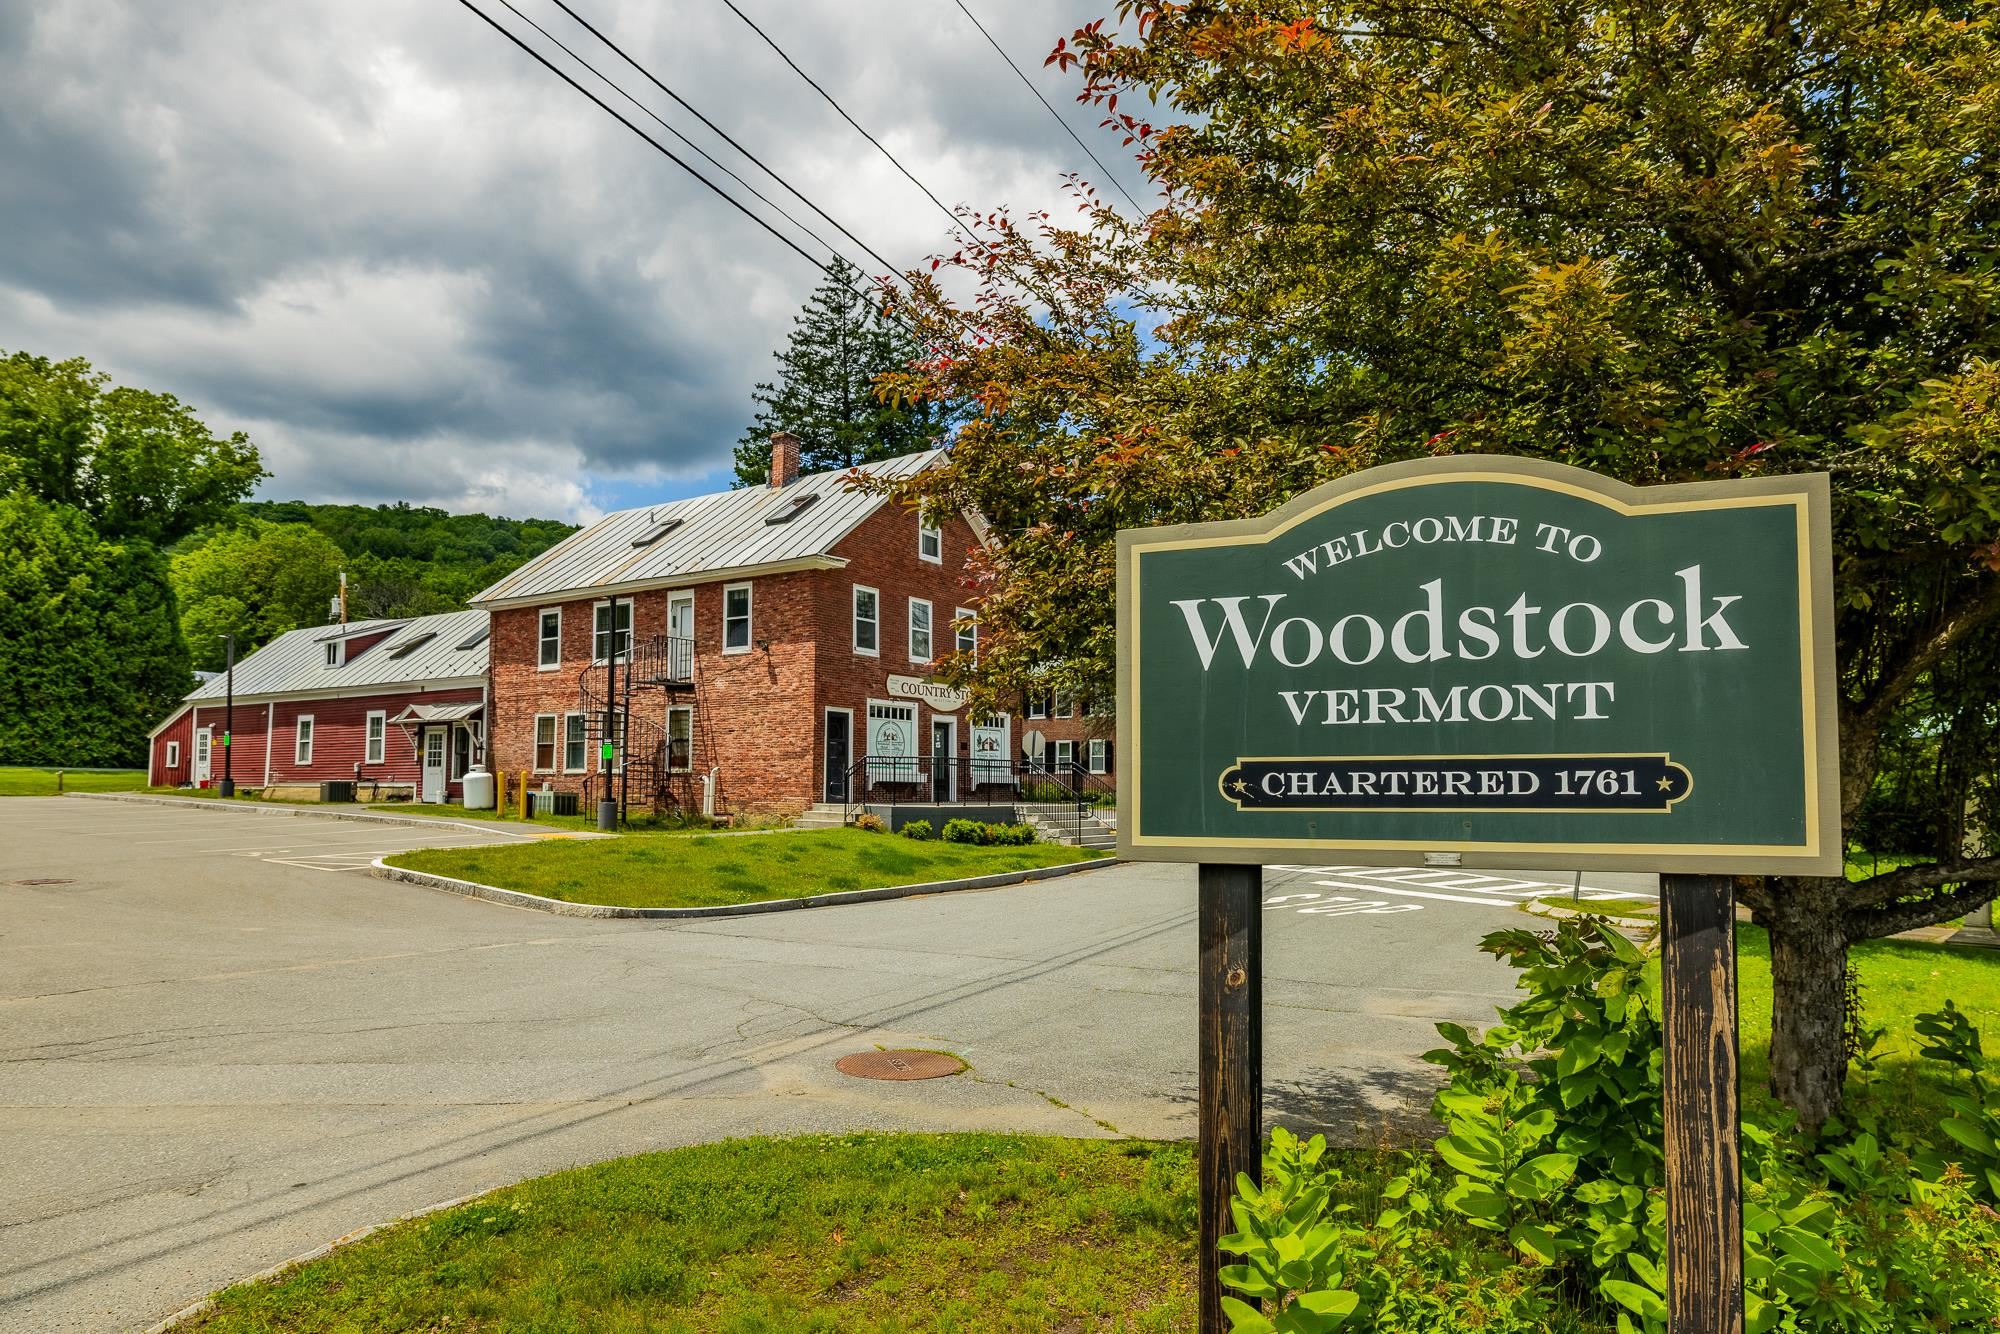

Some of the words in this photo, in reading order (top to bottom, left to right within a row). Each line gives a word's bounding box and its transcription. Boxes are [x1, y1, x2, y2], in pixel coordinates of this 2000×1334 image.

[1282, 515, 1519, 580] WELCOME
[1536, 522, 1603, 563] TO
[1169, 564, 1750, 671] Woodstock
[901, 682, 952, 698] COUNTRY
[1277, 681, 1615, 726] VERMONT
[1261, 771, 1540, 796] CHARTERED
[1554, 769, 1642, 795] 1761
